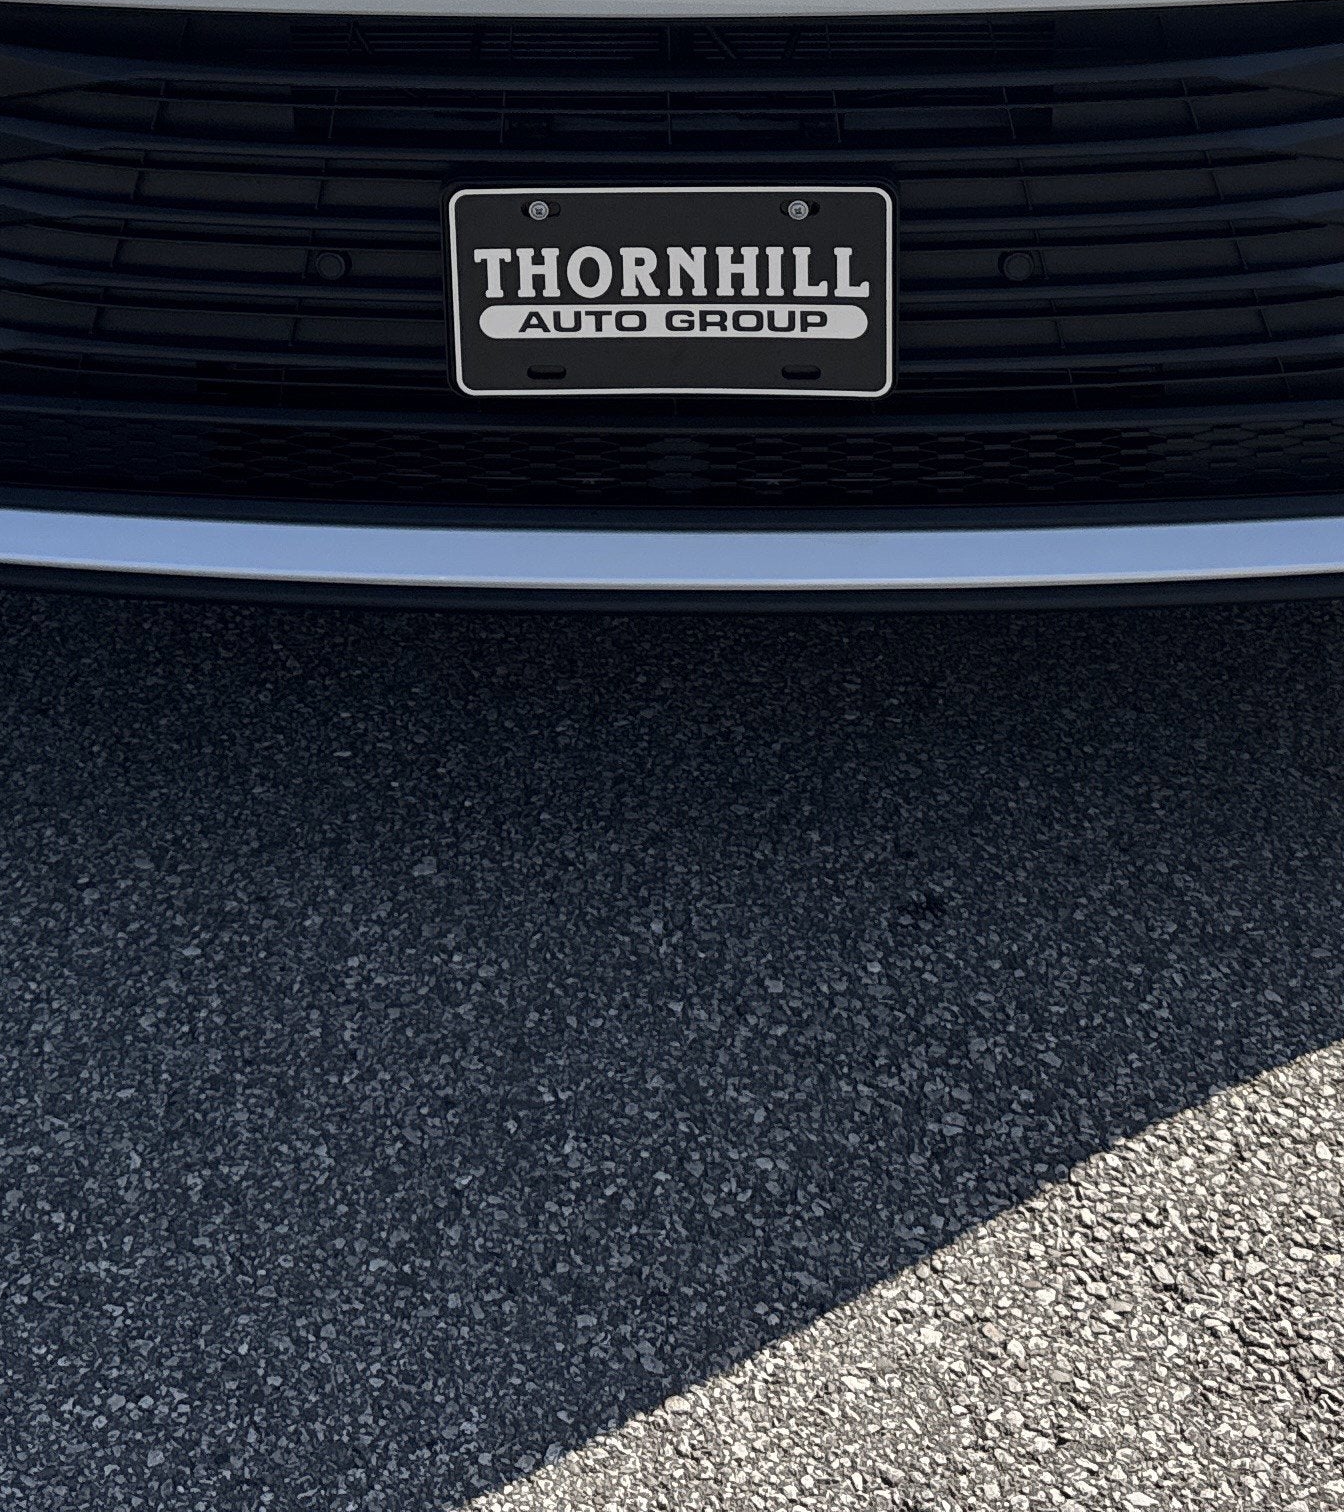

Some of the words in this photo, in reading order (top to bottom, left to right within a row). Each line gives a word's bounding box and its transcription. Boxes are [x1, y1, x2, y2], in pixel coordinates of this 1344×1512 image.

[473, 245, 870, 299] THORNHILL
[518, 310, 648, 333] AUTO
[664, 309, 829, 333] GROUP
